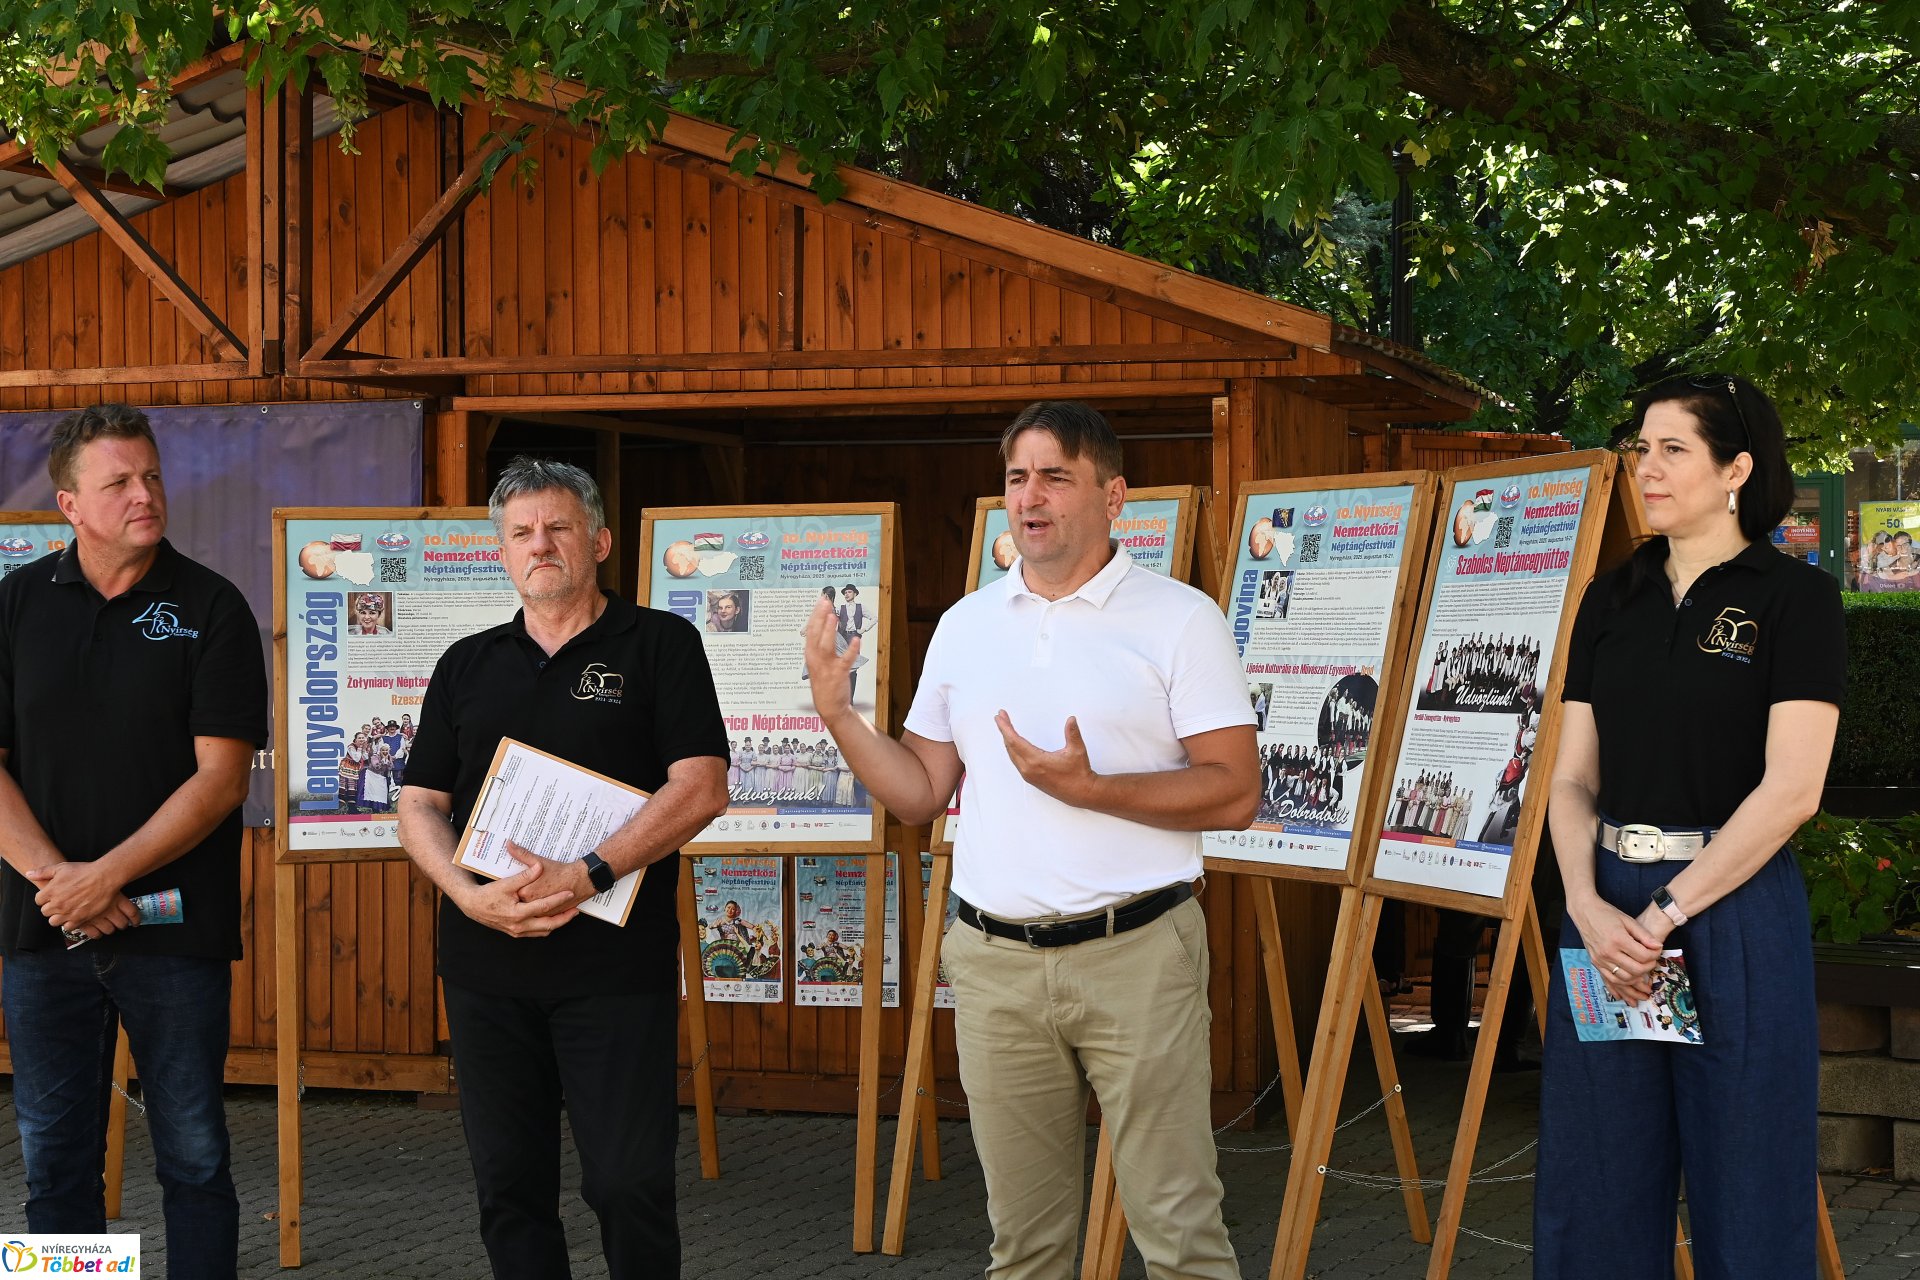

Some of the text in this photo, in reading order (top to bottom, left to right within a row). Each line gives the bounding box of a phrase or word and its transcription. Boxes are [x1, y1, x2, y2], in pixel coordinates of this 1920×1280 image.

[1542, 477, 1583, 500] Nyírség
[1354, 502, 1402, 521] Nyírség
[1524, 500, 1580, 520] Nemzetközi
[1113, 516, 1167, 534] Nyírség
[1333, 522, 1399, 537] Nemzetközi
[1521, 520, 1577, 536] Néptáncfesztivál
[424, 535, 446, 546] 10.
[805, 530, 869, 546] Nyírség
[781, 547, 868, 559] Nemzetközi
[1331, 540, 1396, 553] Néptáncfesztivál
[424, 550, 500, 562] Nemzetkö
[1456, 548, 1570, 576] Szabolcs Néptáncegyüttes
[424, 564, 507, 576] Néptáncfesztiv
[780, 561, 867, 572] Néptáncfesztivál
[161, 625, 199, 639] Nyírség
[1715, 636, 1755, 656] Nyírség
[347, 675, 394, 689] Żołyniacy
[587, 685, 622, 698] Nyírség
[1455, 680, 1517, 711] Üdvözlünk!
[299, 592, 345, 811] Lengyelország
[752, 713, 827, 733] Néptáncegy
[727, 781, 826, 806] Üdvözlünk!
[721, 868, 777, 878] Nemzetközi
[721, 878, 776, 886] Néptáncfesztivál
[1578, 968, 1597, 1024] Nemzetközi
